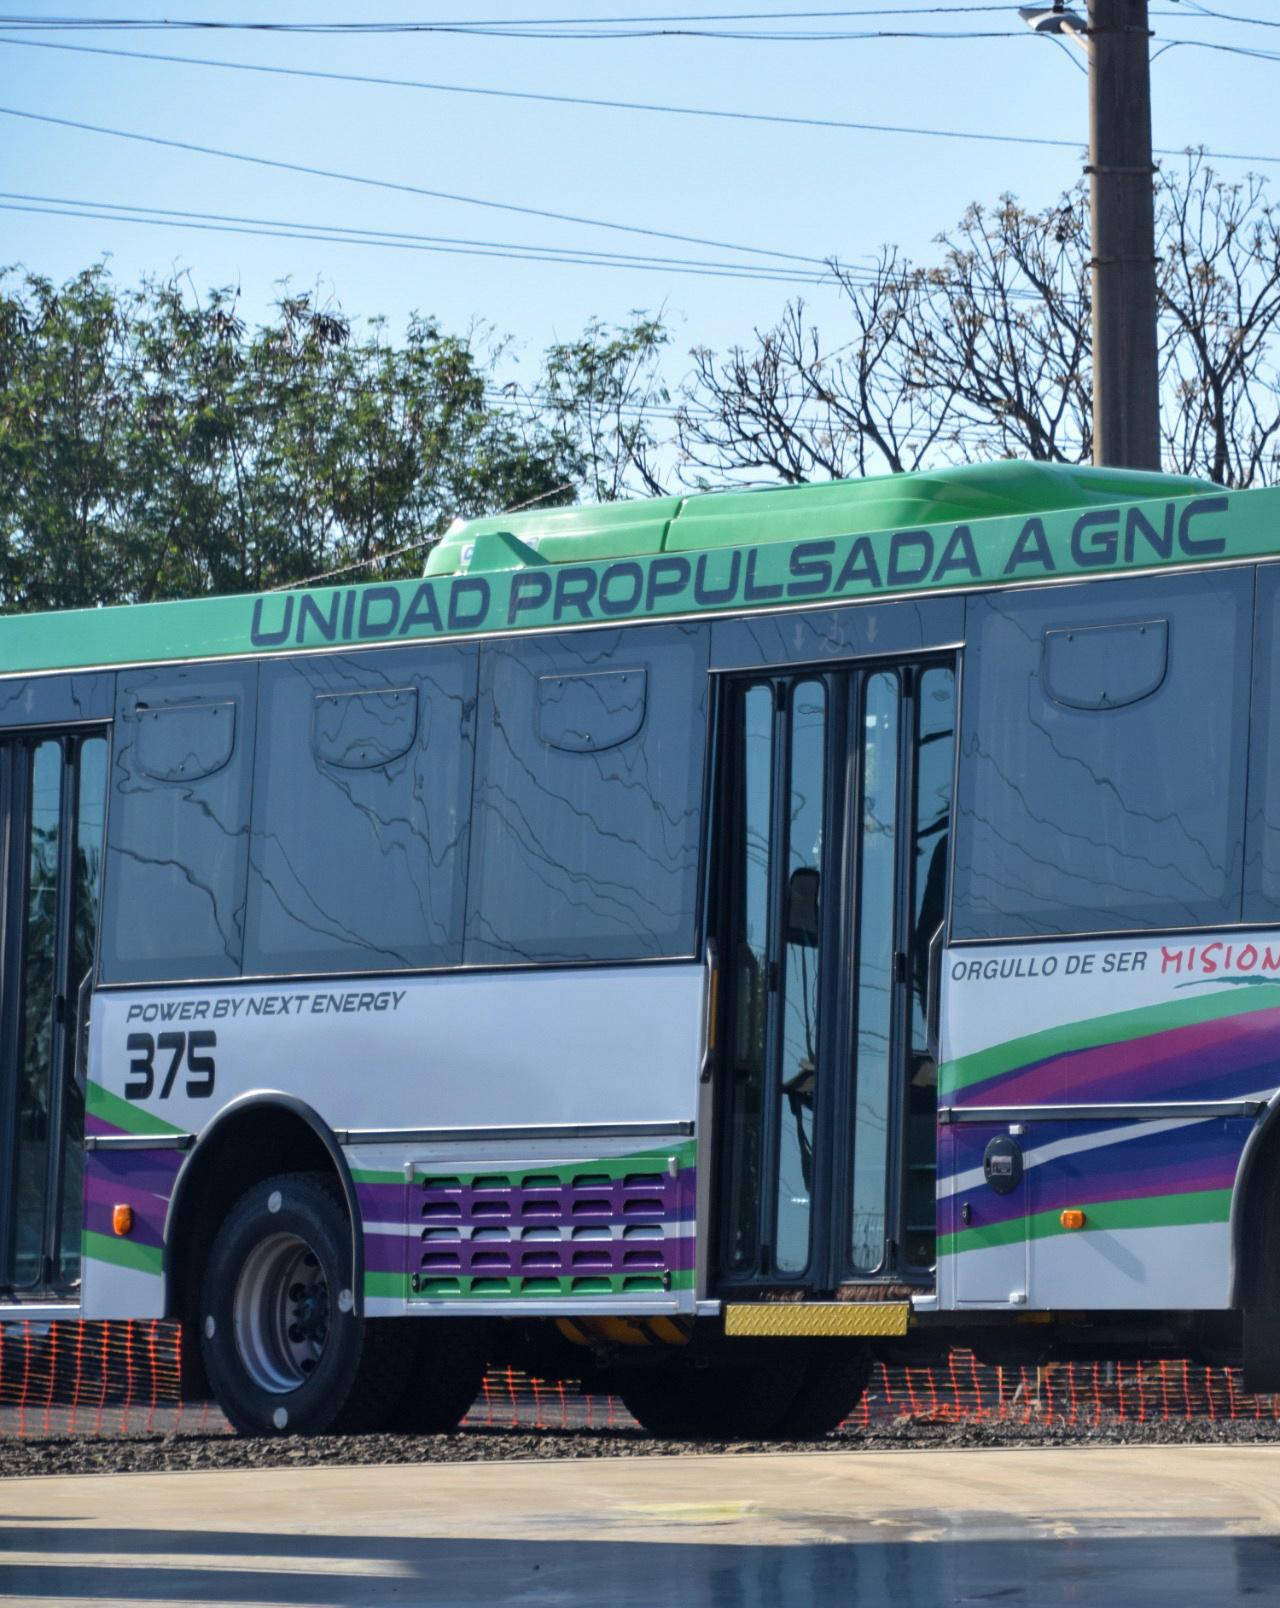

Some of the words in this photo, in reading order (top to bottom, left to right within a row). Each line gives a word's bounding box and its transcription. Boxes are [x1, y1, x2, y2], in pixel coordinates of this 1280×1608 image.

[250, 576, 491, 648] UNIDAD
[507, 525, 982, 625] PROPULSADA
[1003, 517, 1056, 575] A
[1071, 497, 1229, 567] GNC
[951, 955, 1058, 982] ORGULLO
[1064, 953, 1094, 975] DE
[1101, 950, 1148, 974] SER
[126, 999, 211, 1023] POWER
[213, 997, 244, 1018] BY
[245, 995, 310, 1017] NEXT
[310, 990, 407, 1014] ENERGY
[124, 1029, 217, 1101] 375
